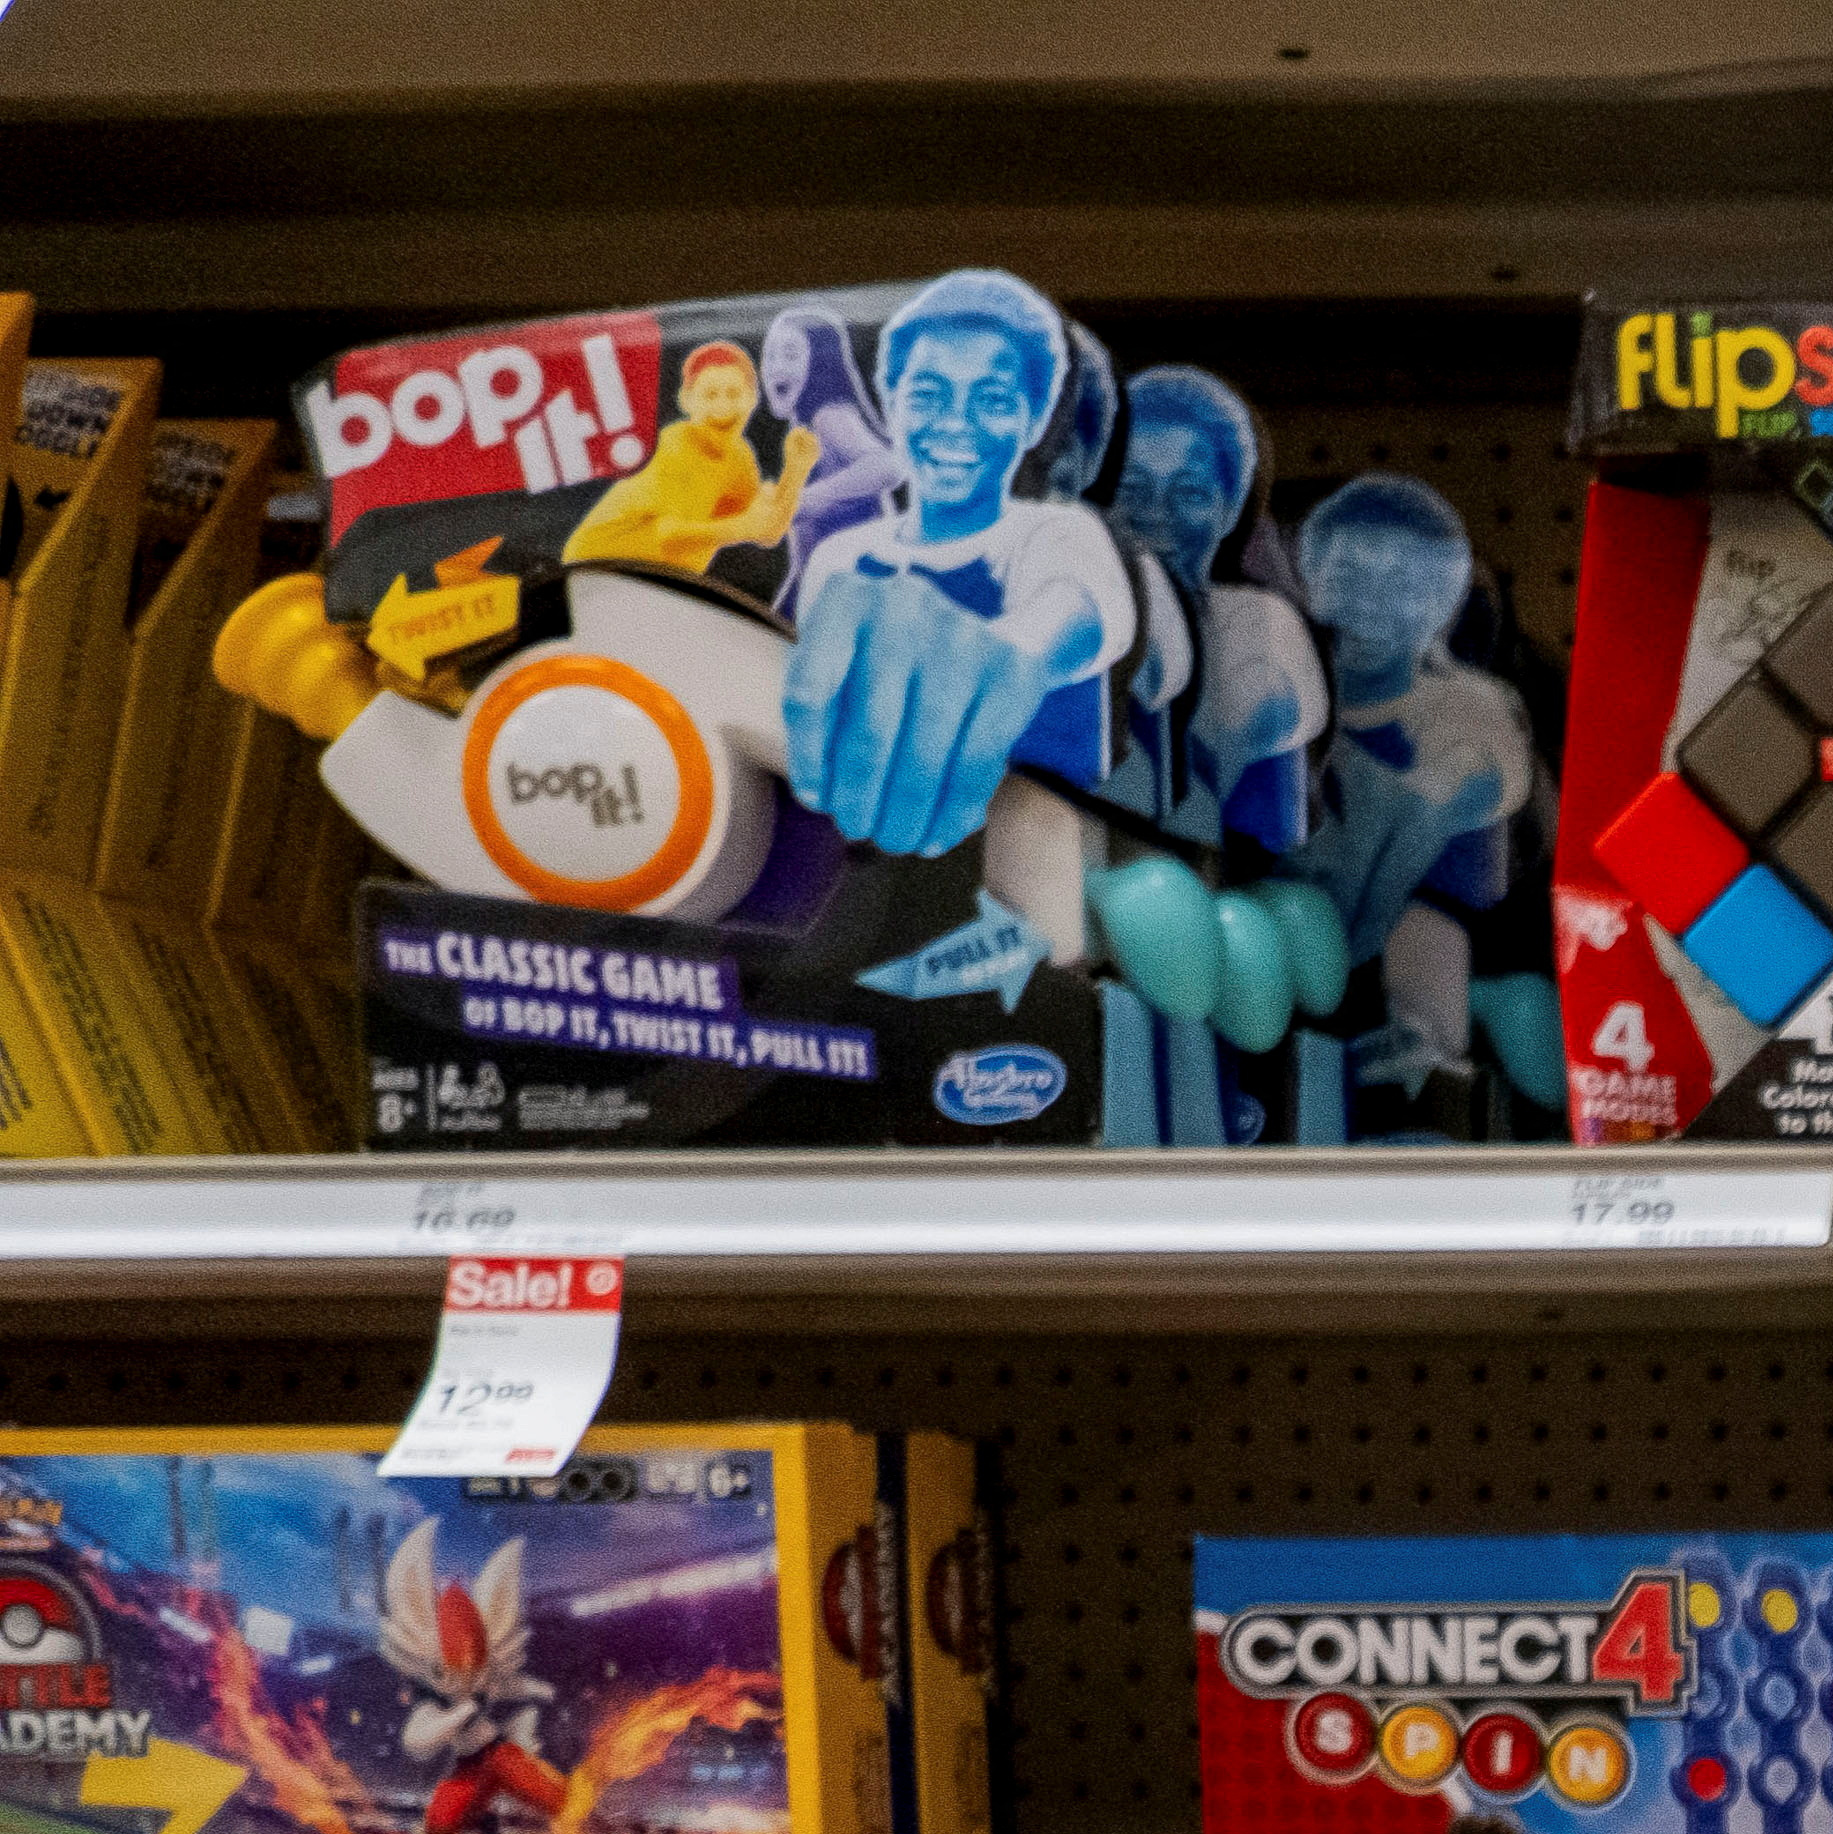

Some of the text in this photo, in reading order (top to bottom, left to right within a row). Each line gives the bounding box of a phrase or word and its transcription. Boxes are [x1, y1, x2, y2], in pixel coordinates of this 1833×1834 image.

[308, 344, 545, 480] bop
[513, 334, 650, 493] it!
[507, 762, 644, 828] bop it!
[386, 933, 725, 1012] THE CLASSIC GAME
[503, 1003, 566, 1036] BOP
[613, 1016, 702, 1057] TWIST
[751, 1030, 820, 1073] PULL
[1594, 1001, 1655, 1072] 4
[1777, 1112, 1808, 1135] to
[1570, 1200, 1675, 1226] 17.99
[450, 1262, 574, 1309] Sale!
[1233, 1582, 1683, 1700] CONNECT 4
